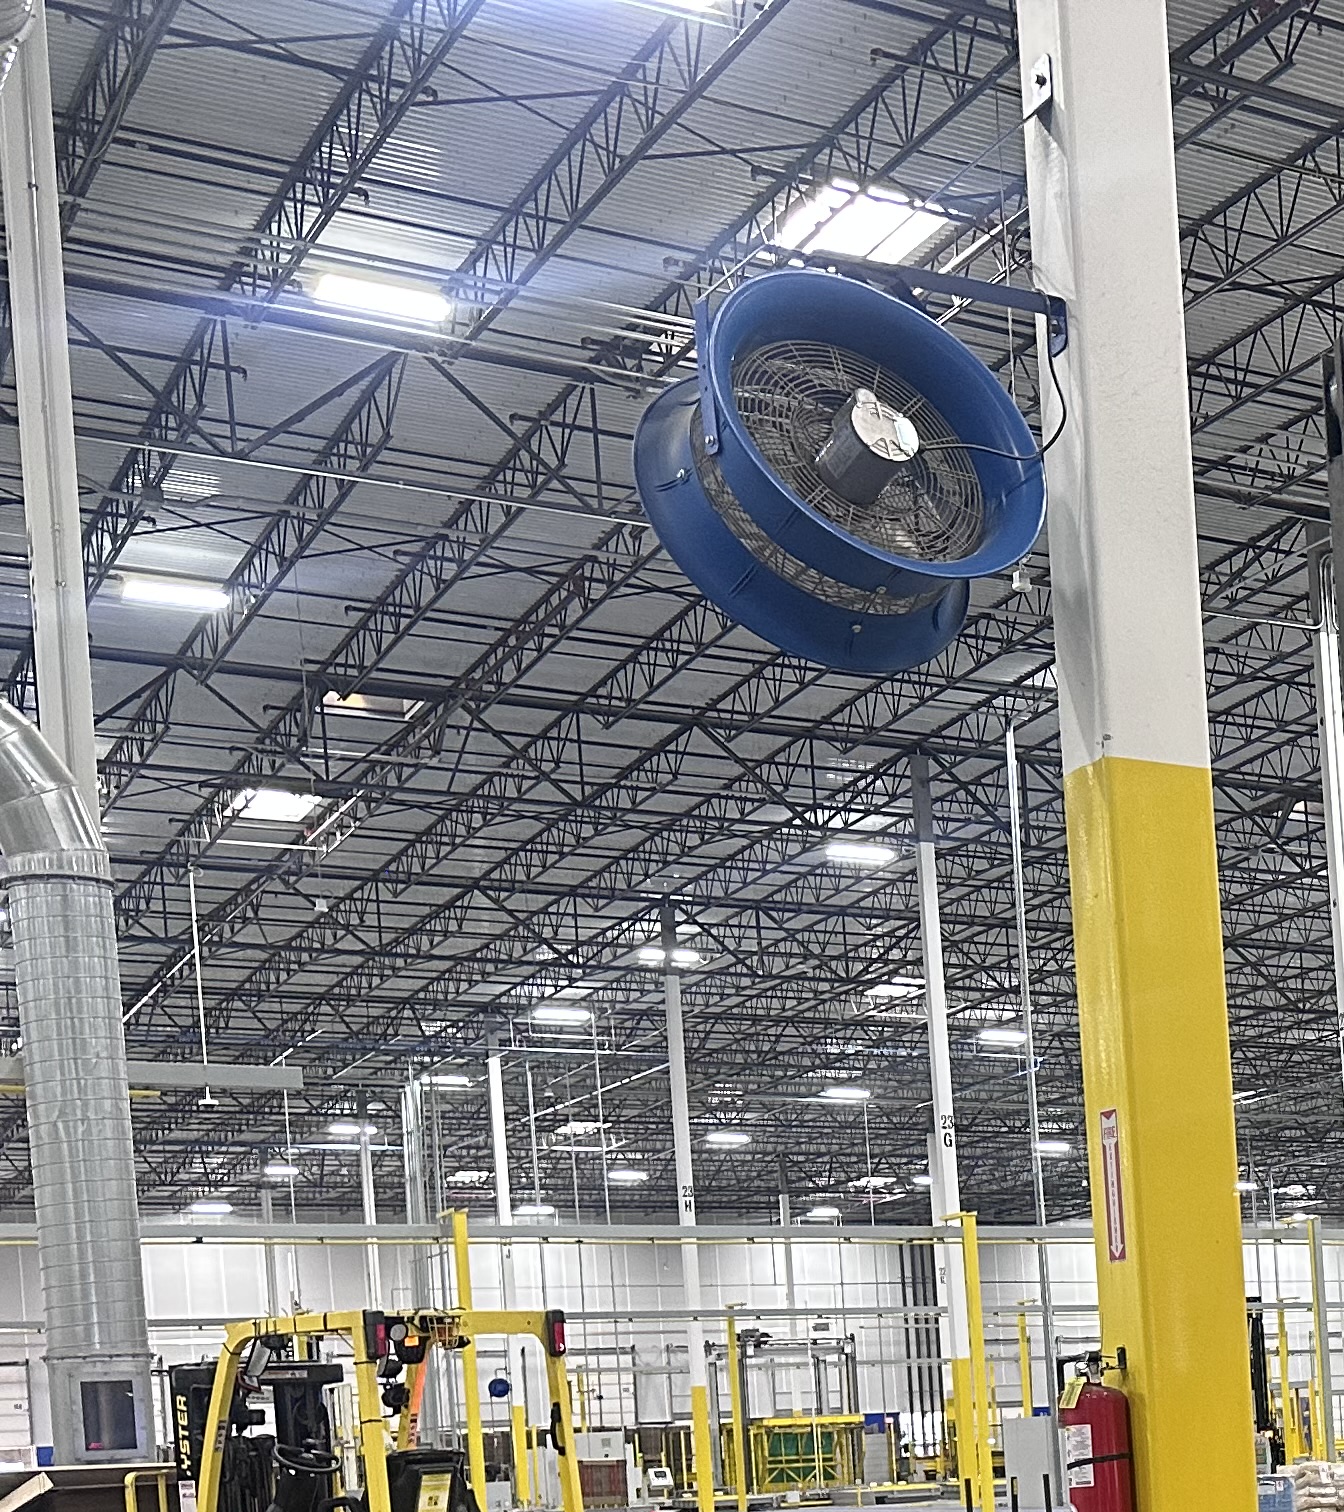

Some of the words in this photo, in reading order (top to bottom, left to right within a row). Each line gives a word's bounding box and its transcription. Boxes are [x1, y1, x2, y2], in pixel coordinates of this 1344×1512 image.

[941, 1115, 954, 1129] 23
[943, 1133, 952, 1147] G
[682, 1185, 693, 1197] 23
[685, 1200, 692, 1212] H
[176, 1395, 192, 1477] YSTER
